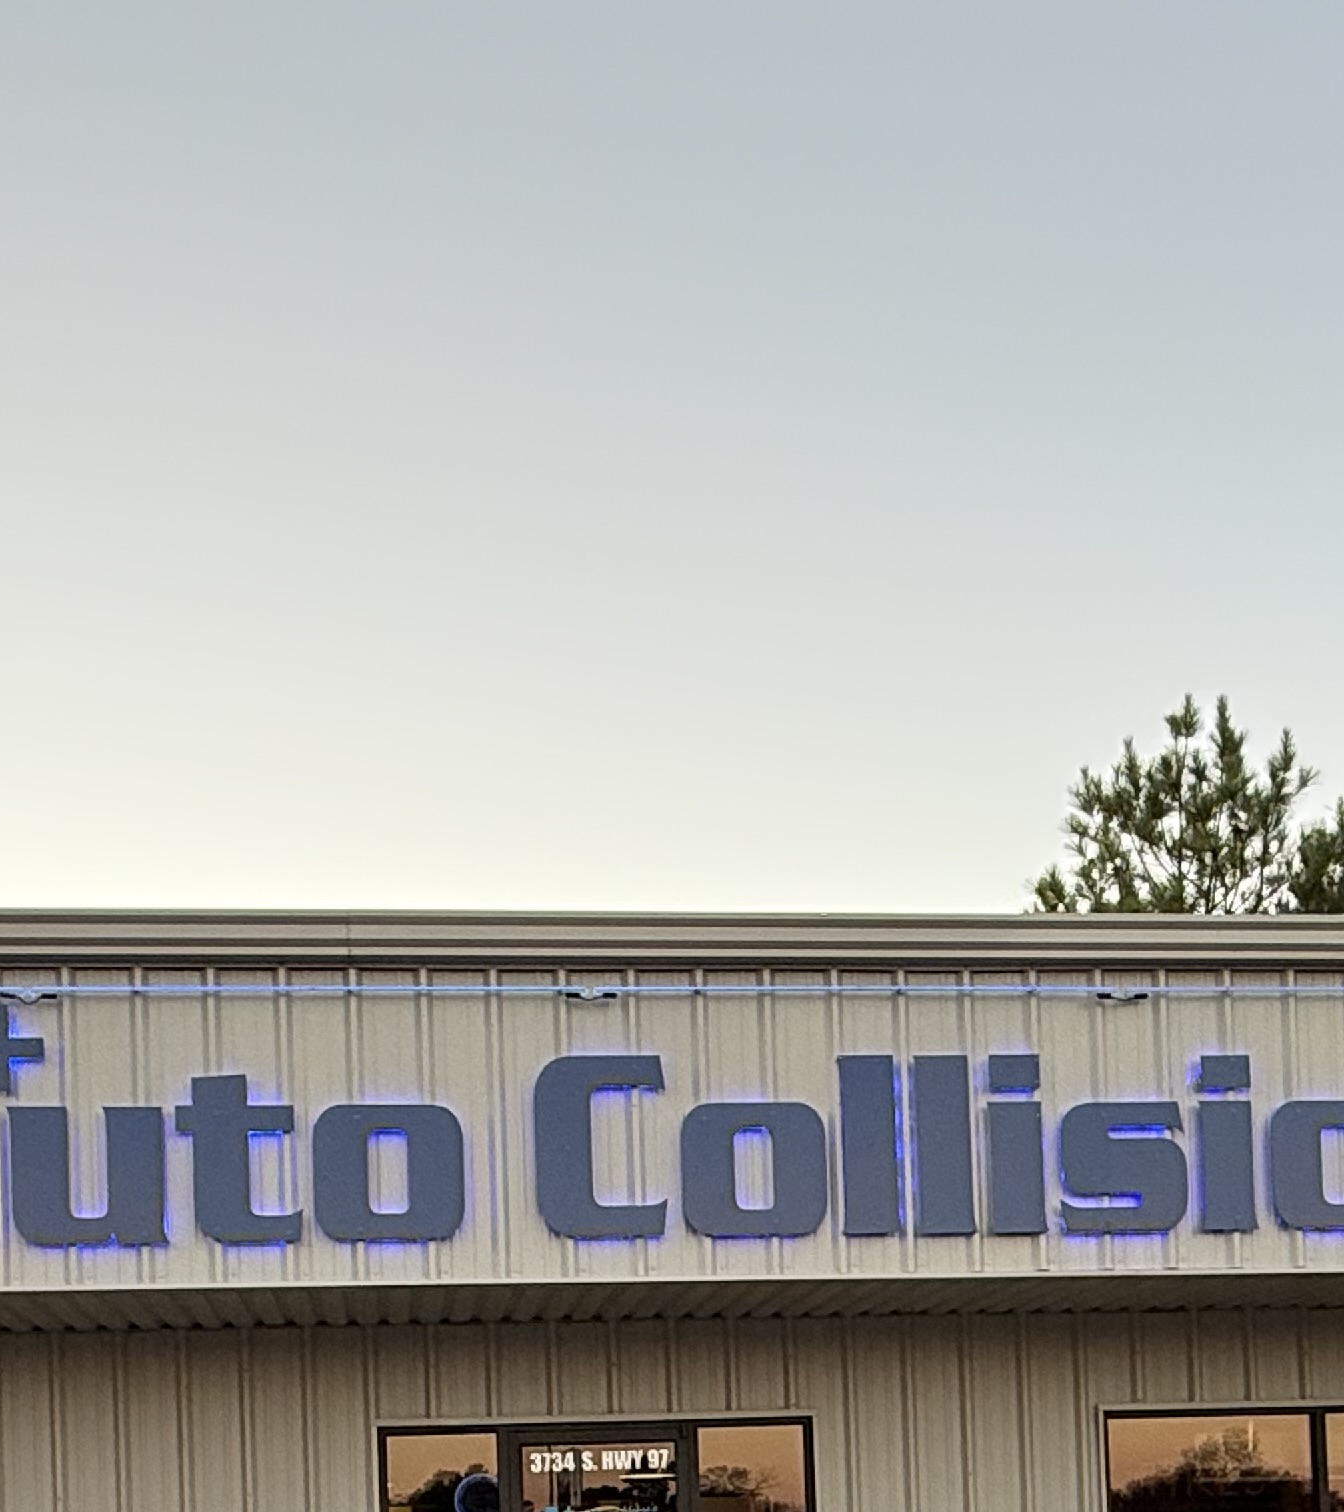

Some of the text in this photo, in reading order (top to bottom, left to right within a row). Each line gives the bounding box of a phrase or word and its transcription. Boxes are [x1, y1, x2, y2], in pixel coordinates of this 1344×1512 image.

[529, 1449, 669, 1473] 3734 S. HWY 97
